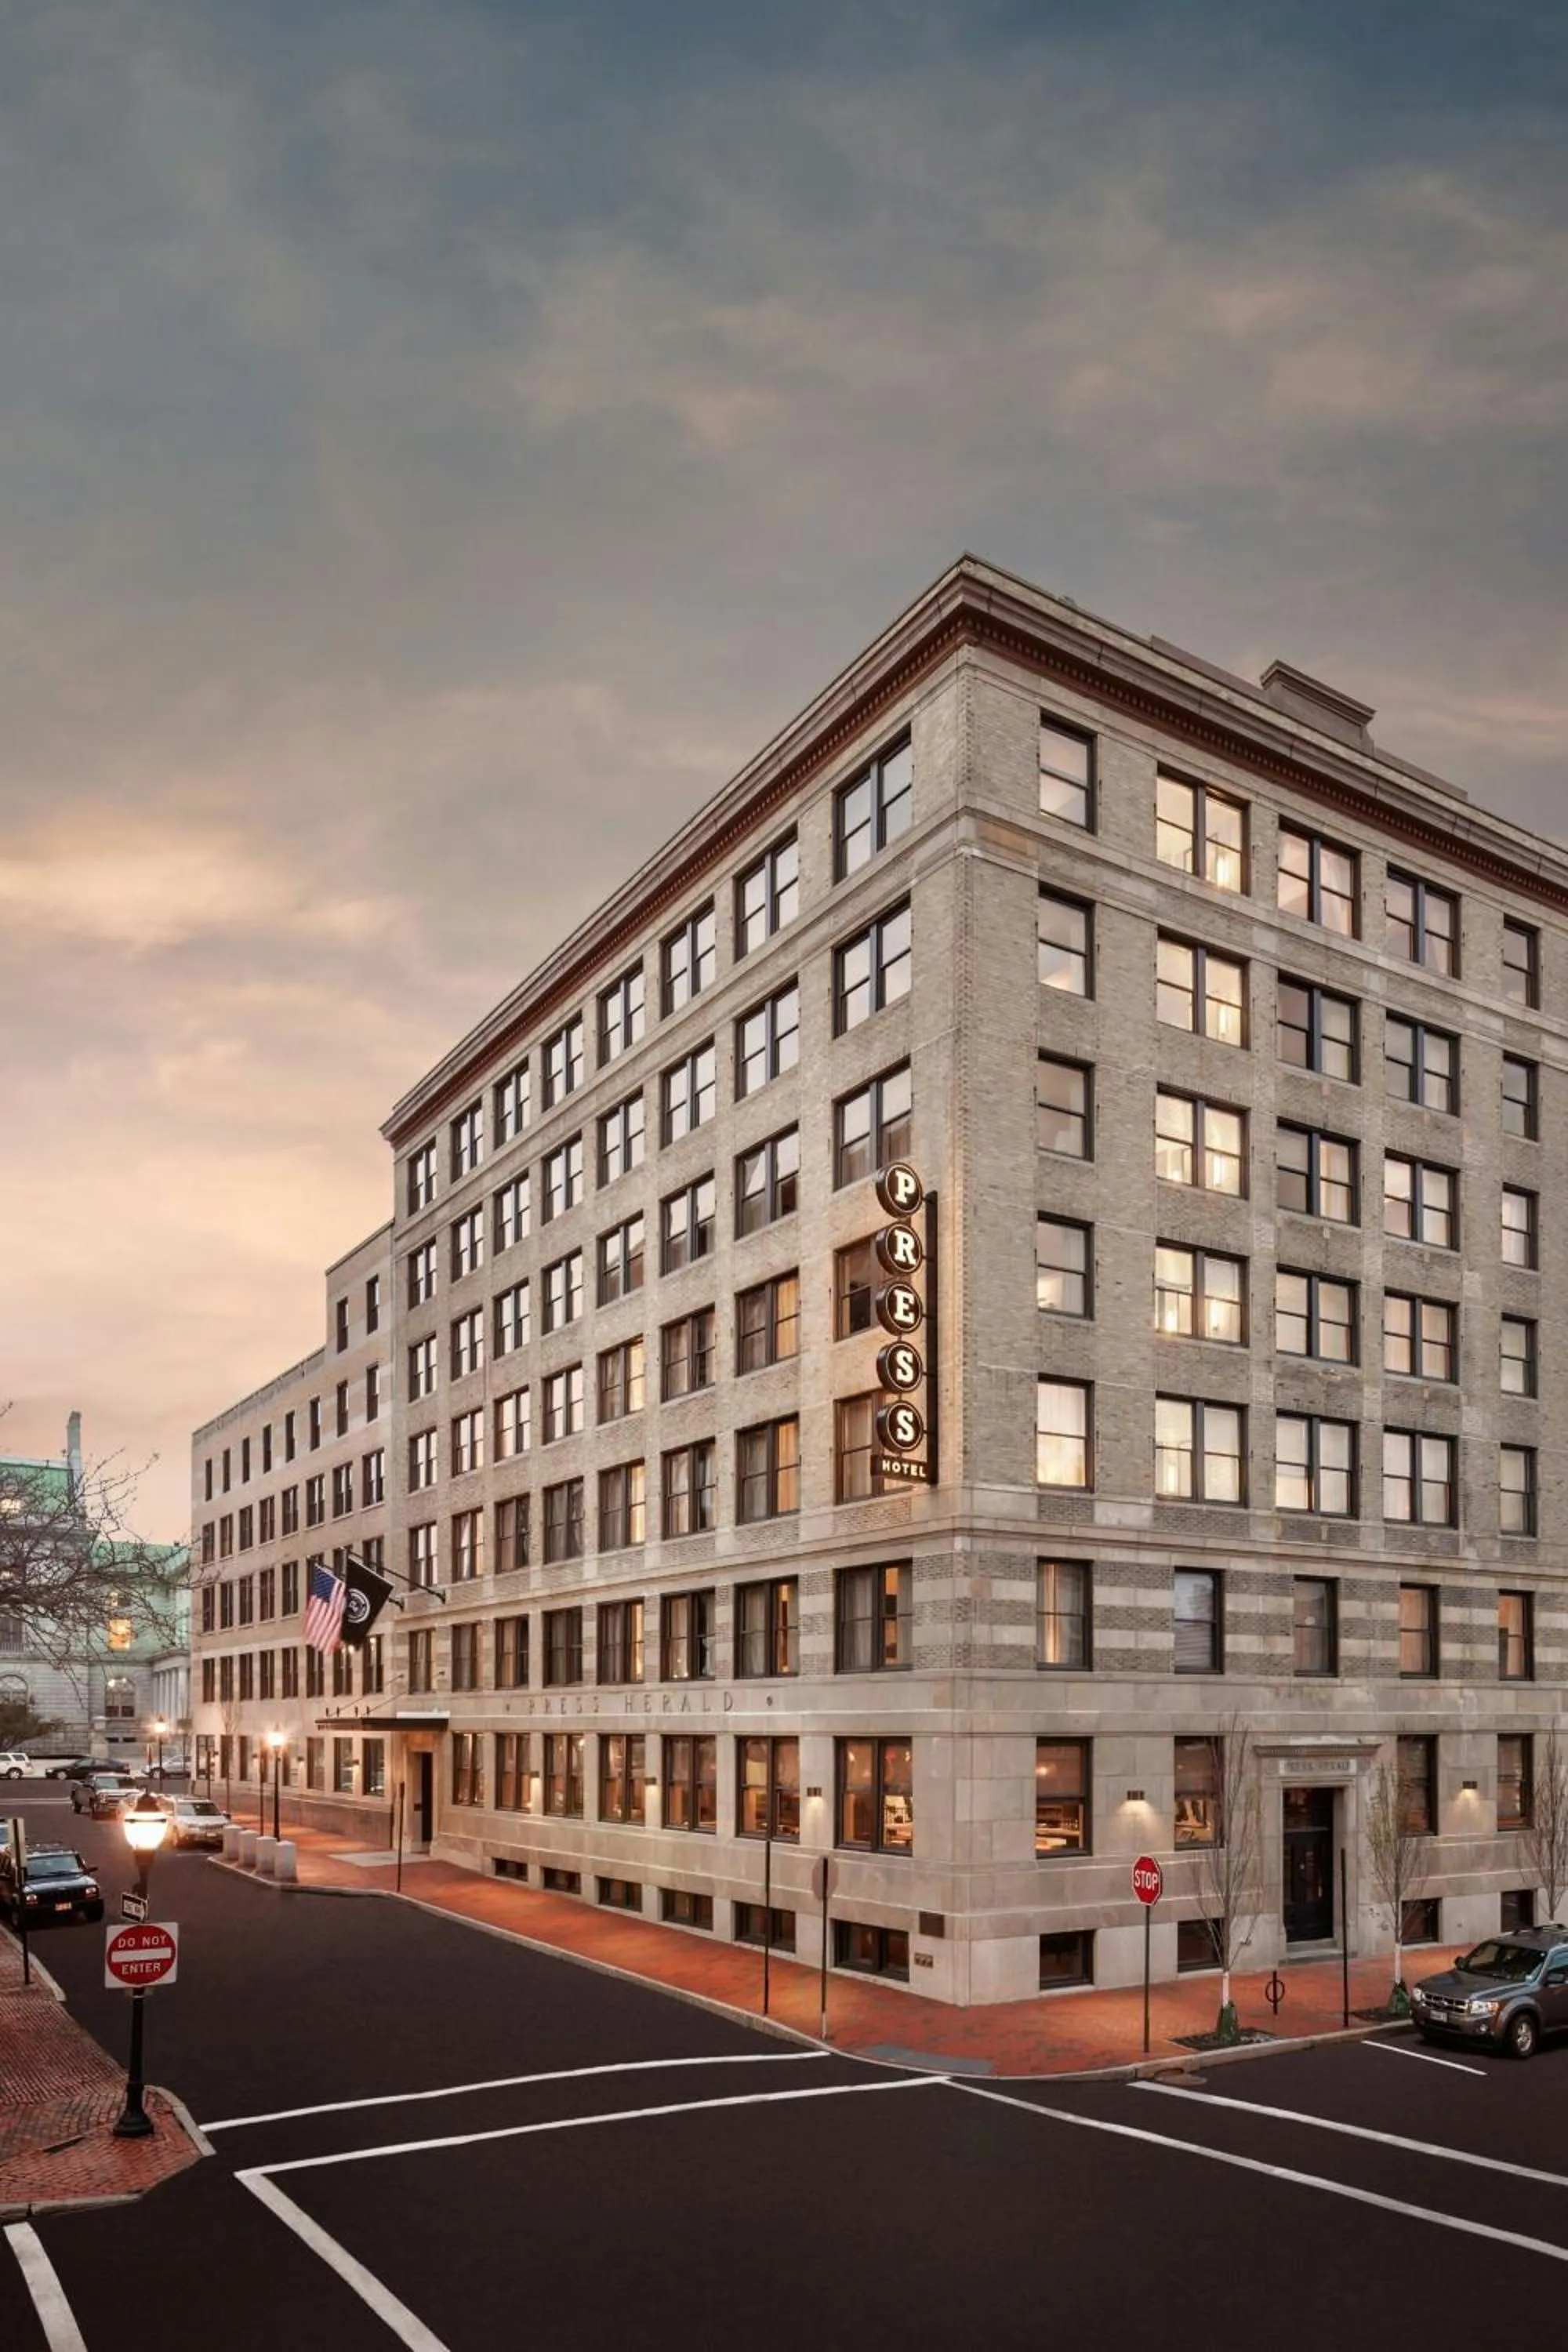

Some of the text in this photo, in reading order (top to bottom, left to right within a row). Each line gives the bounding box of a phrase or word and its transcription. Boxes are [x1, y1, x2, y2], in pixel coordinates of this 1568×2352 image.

[894, 1171, 916, 1443] PRESS
[882, 1459, 927, 1478] HOTEL
[528, 1690, 734, 1715] PRESS HERALD
[1134, 1869, 1158, 1891] STOP
[118, 1934, 167, 1948] DO NOT
[122, 1962, 162, 1975] ENTER
